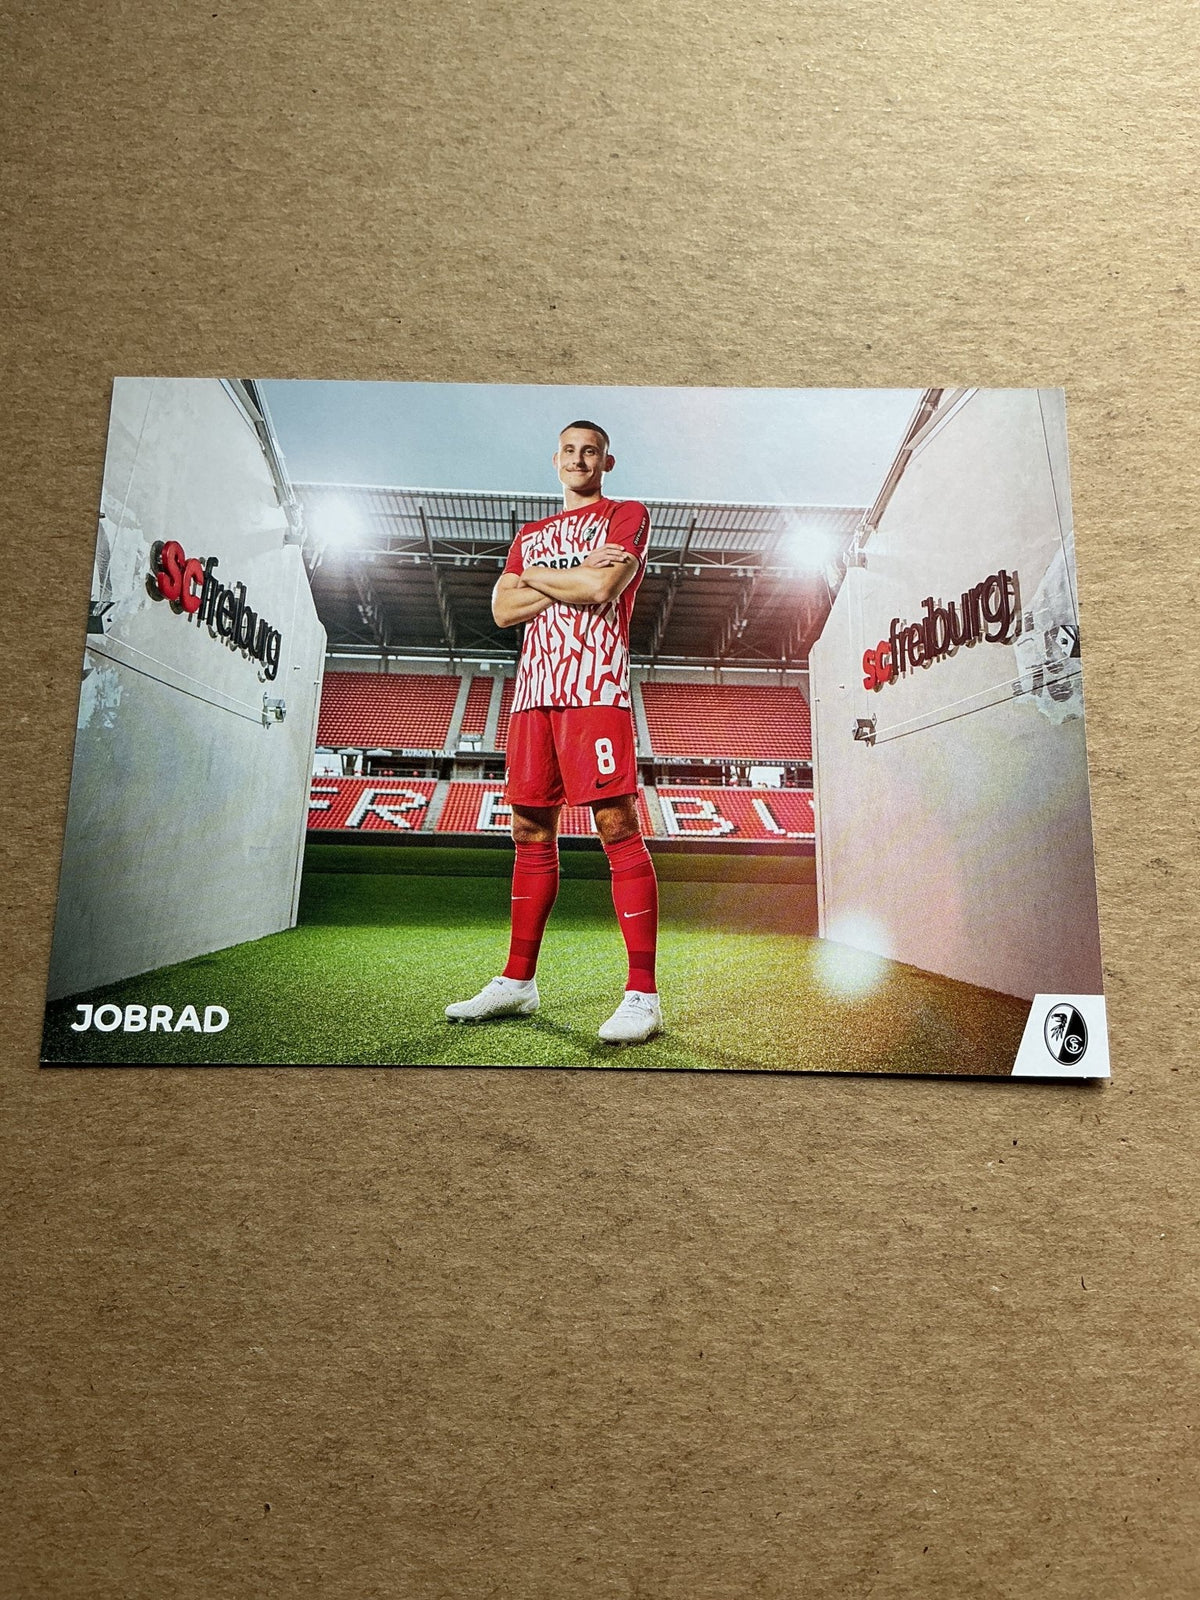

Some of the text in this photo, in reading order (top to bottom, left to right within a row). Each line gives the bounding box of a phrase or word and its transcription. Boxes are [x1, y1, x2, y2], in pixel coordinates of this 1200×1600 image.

[532, 555, 589, 570] BRA
[594, 737, 616, 775] 8
[71, 1004, 230, 1033] JOBRAD
